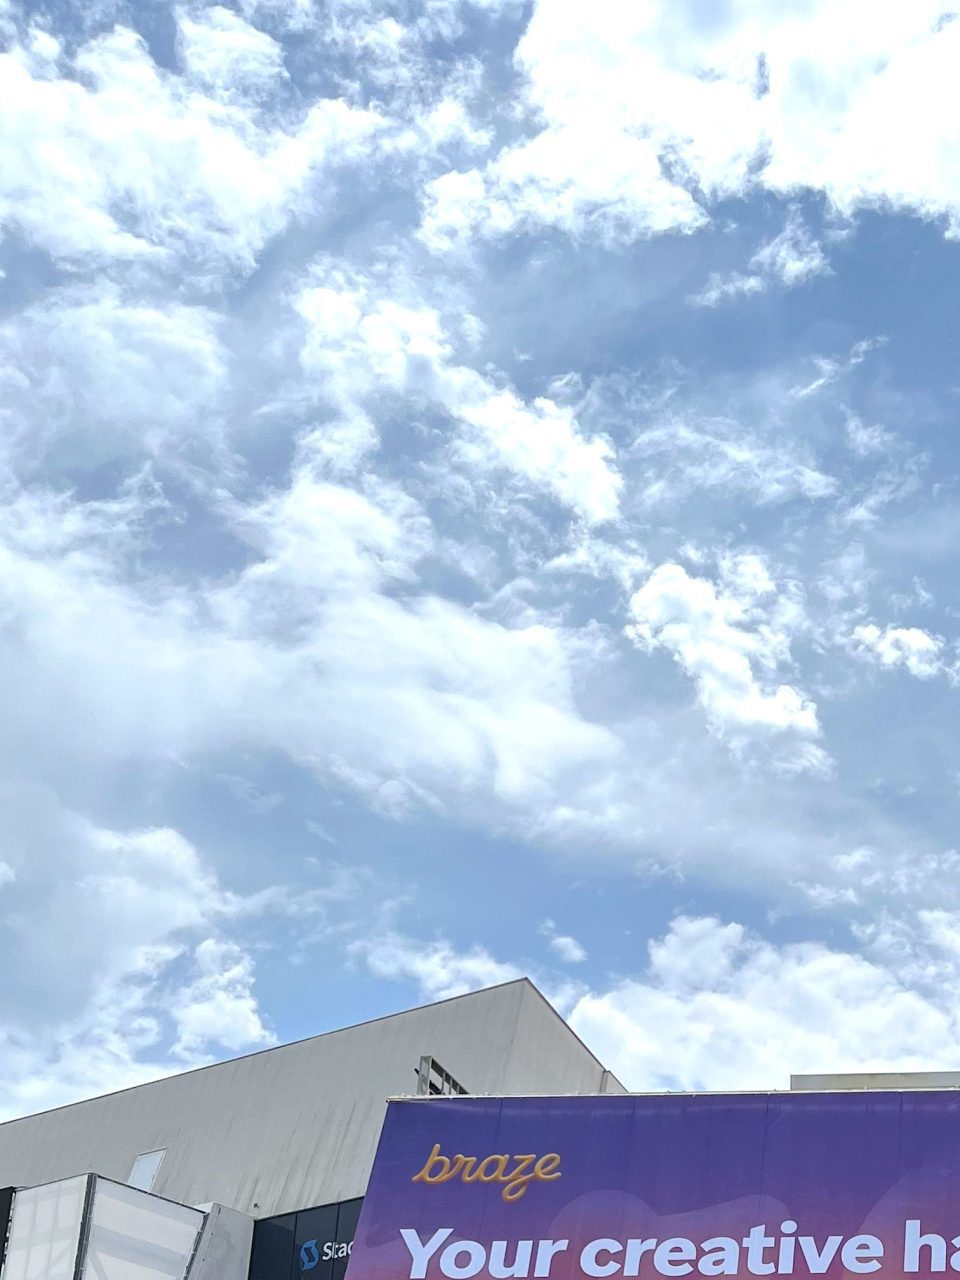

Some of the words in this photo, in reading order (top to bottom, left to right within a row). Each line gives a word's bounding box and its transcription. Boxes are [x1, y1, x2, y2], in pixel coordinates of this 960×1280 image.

[412, 1144, 562, 1202] braze
[400, 1228, 569, 1279] Your
[580, 1220, 884, 1277] creative
